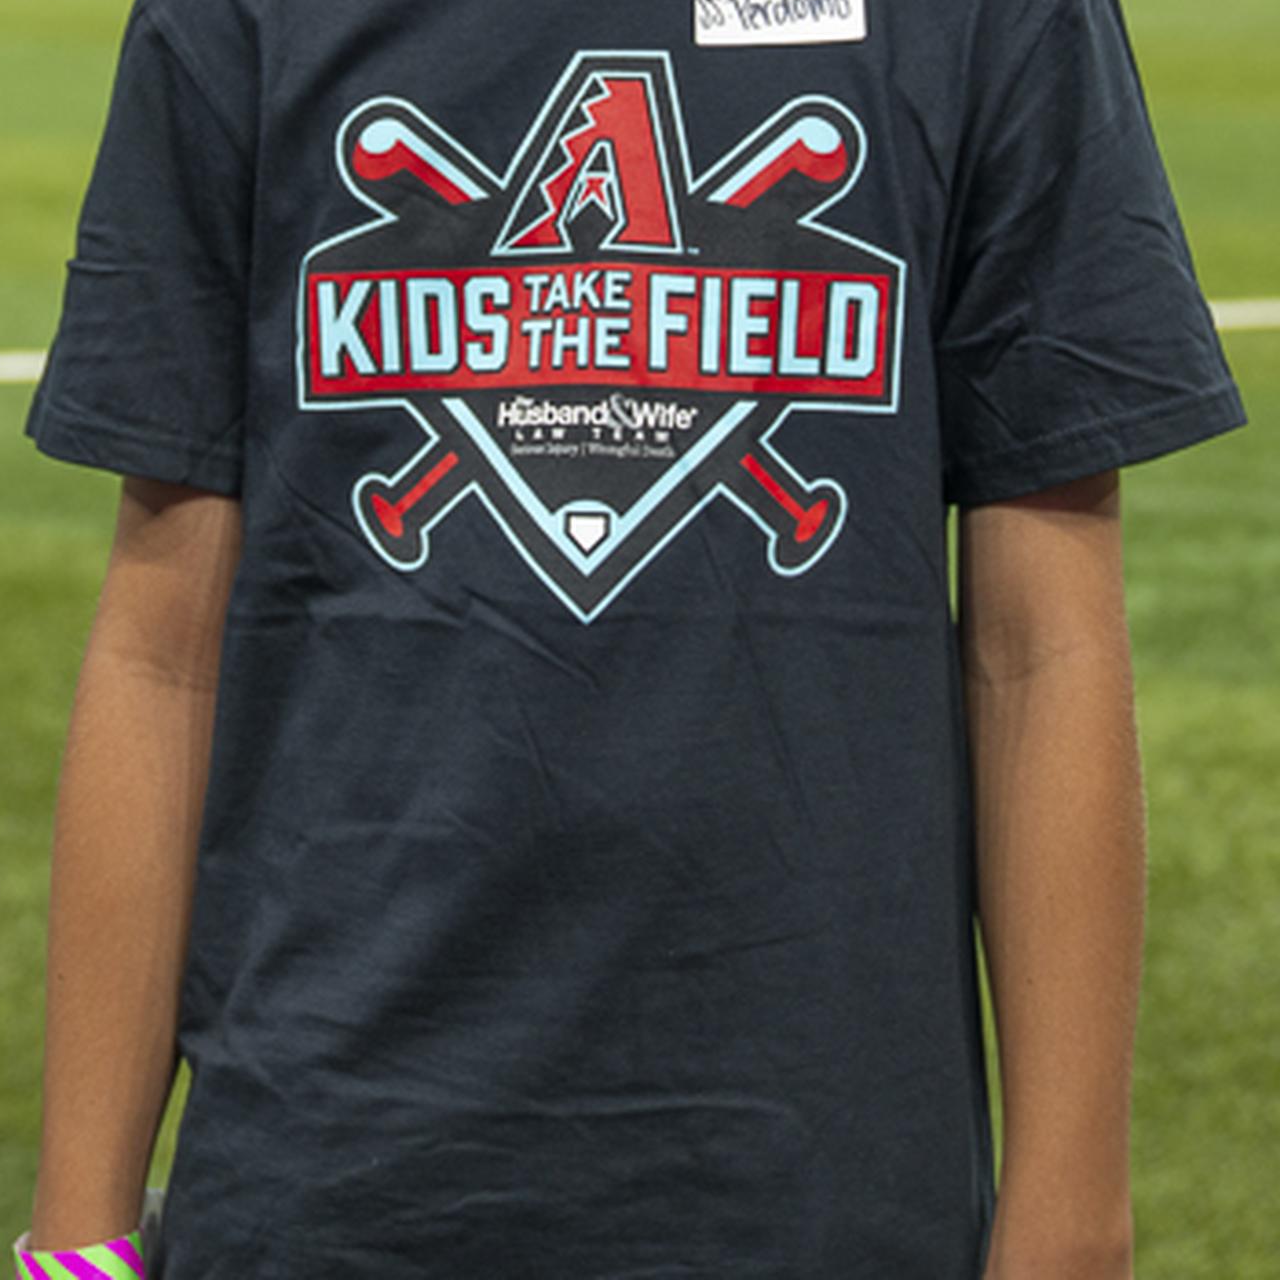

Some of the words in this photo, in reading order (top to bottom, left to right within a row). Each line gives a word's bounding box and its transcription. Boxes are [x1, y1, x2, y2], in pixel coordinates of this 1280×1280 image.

[490, 71, 683, 256] A
[317, 276, 511, 377] KIDS
[523, 271, 632, 312] TAKE
[646, 272, 881, 378] FIELD
[521, 317, 630, 369] THE
[497, 401, 608, 427] Husband
